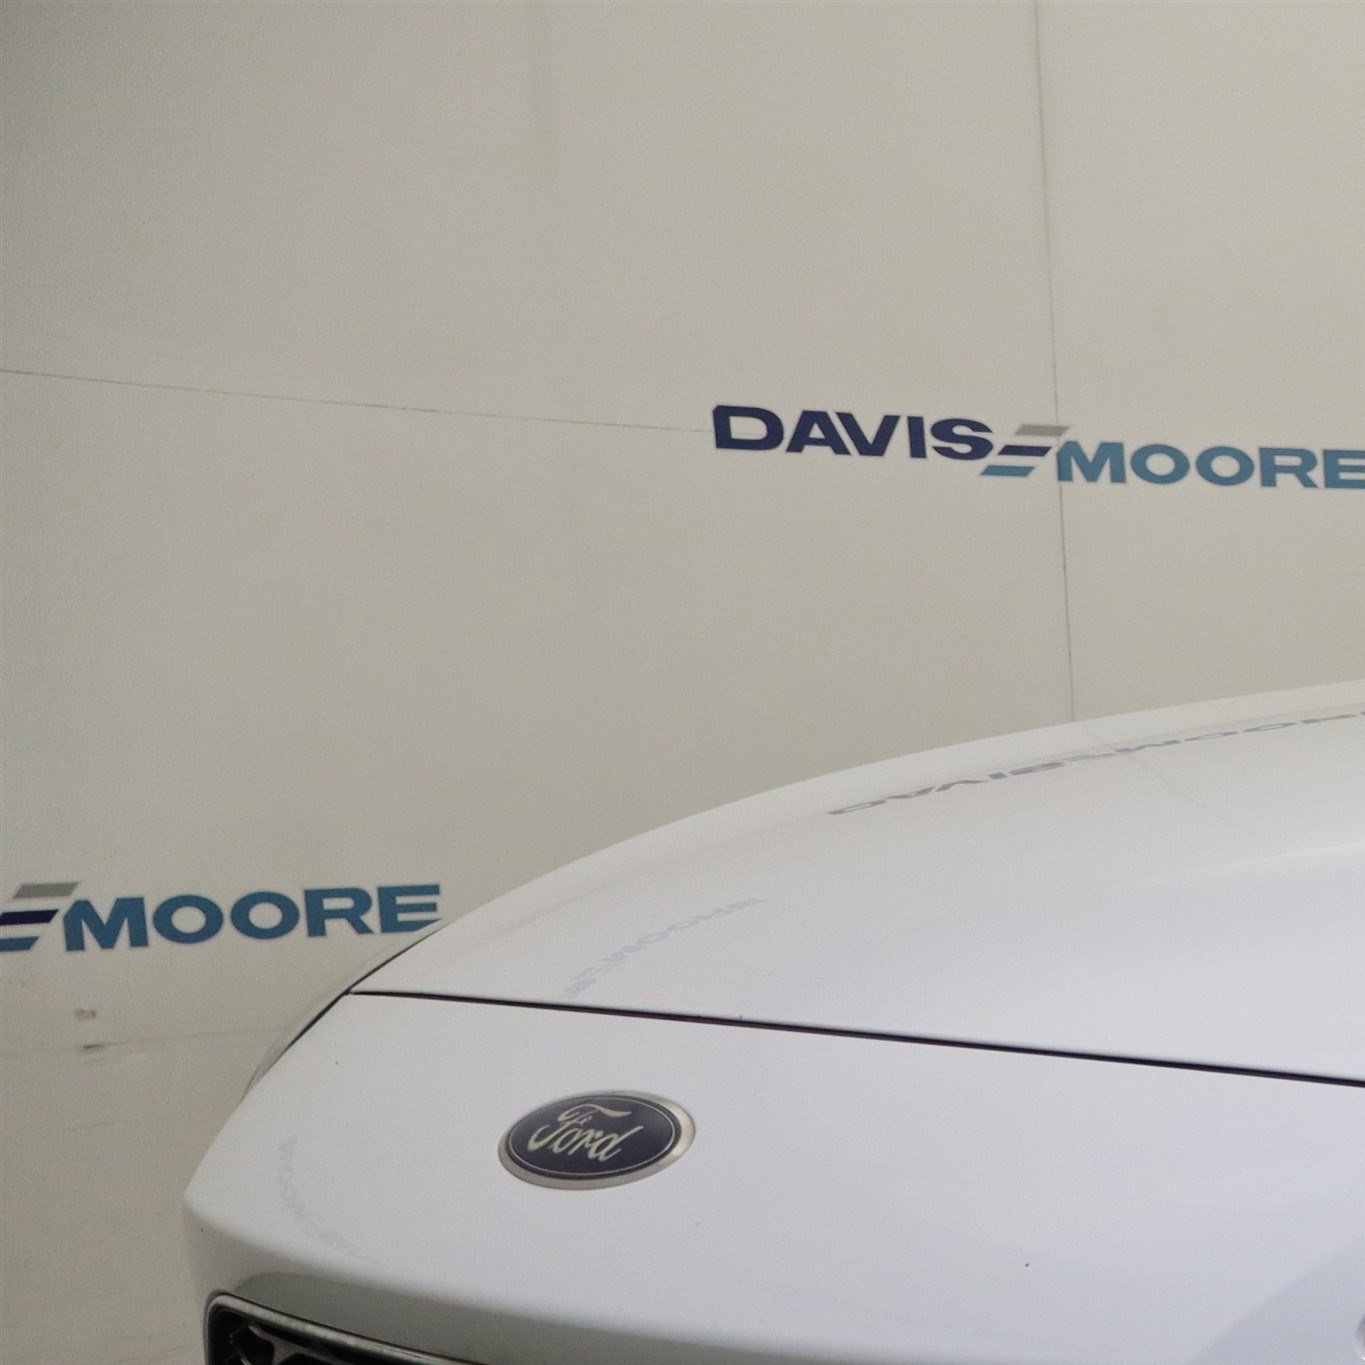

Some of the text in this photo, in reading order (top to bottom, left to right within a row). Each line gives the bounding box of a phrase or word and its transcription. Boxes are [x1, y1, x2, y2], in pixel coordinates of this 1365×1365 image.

[711, 404, 995, 461] DAVIS
[62, 883, 443, 953] MOORE
[526, 1102, 645, 1162] Ford
